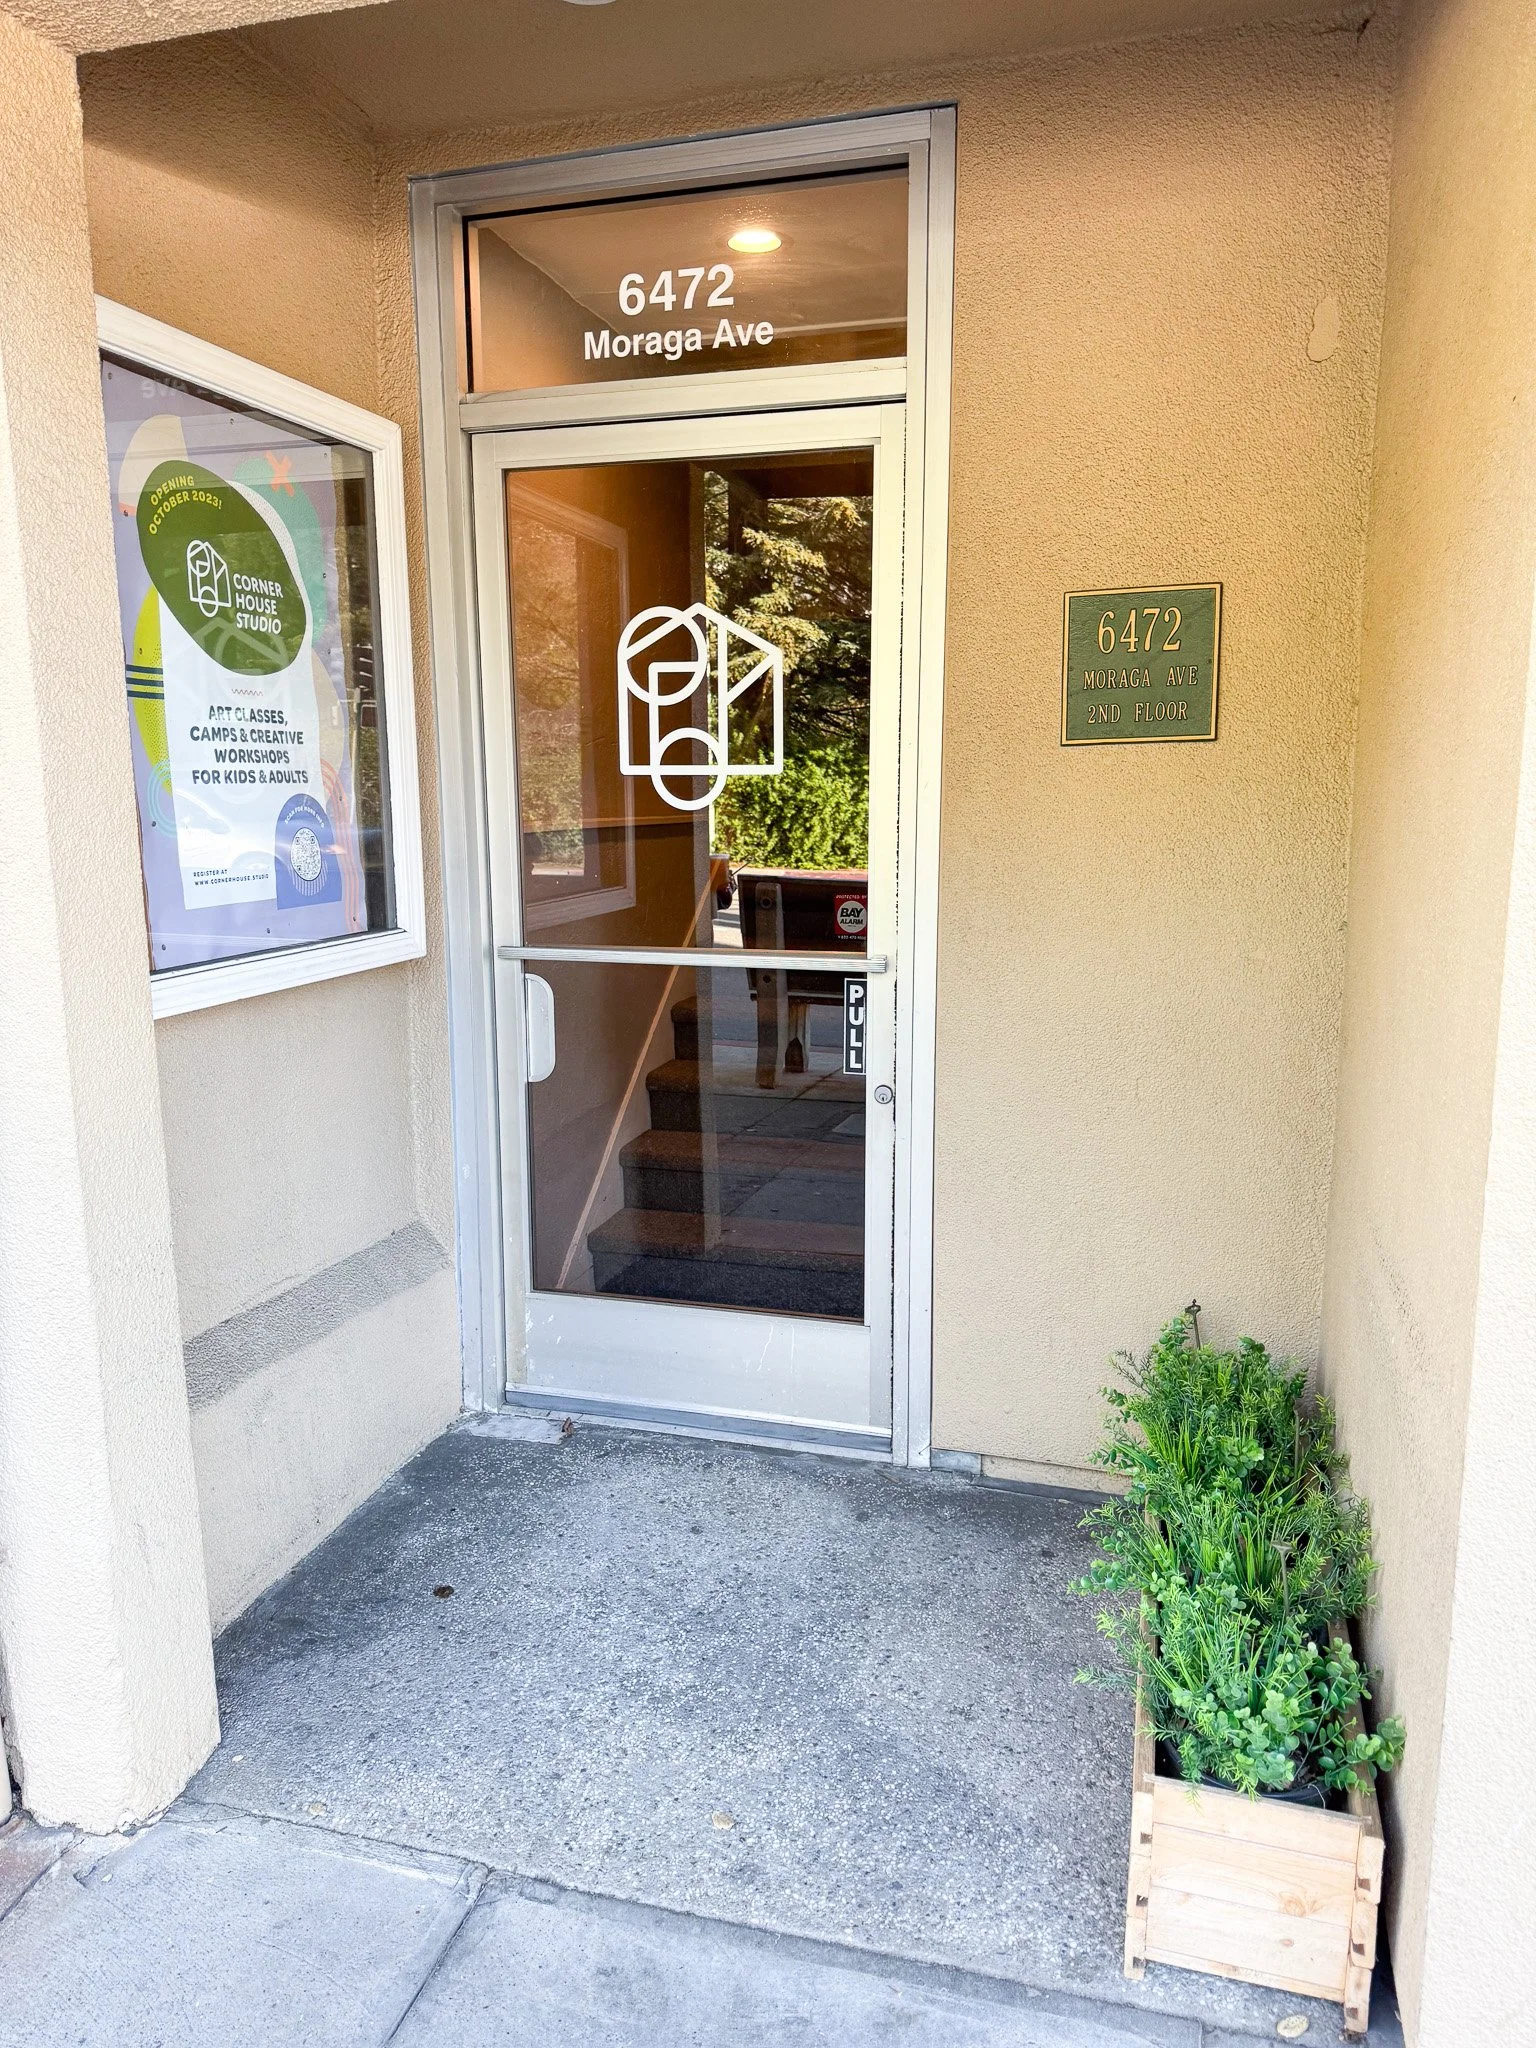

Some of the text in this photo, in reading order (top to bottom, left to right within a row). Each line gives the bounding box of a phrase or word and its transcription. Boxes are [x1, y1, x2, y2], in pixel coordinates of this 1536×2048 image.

[618, 263, 735, 316] 6472
[584, 318, 774, 361] Moraga Ave
[150, 475, 195, 506] OPENING
[149, 489, 222, 535] OCTOBER 2023!
[233, 573, 284, 598] CORNER
[235, 592, 278, 616] HOUSE
[236, 612, 282, 635] STUDIO
[1097, 606, 1183, 655] 6472
[1083, 665, 1199, 690] MORAGA AVE
[208, 705, 288, 726] ART CLASSES,
[1087, 701, 1188, 724] 2ND FLOOR
[189, 726, 304, 744] CAMPS & CREATIVE
[214, 748, 290, 764] WORKSHOPS
[192, 769, 309, 784] FOR KIDS & ADULTS
[193, 869, 220, 877] REGISTER
[840, 907, 864, 917] BAY
[849, 984, 865, 1069] PULL
